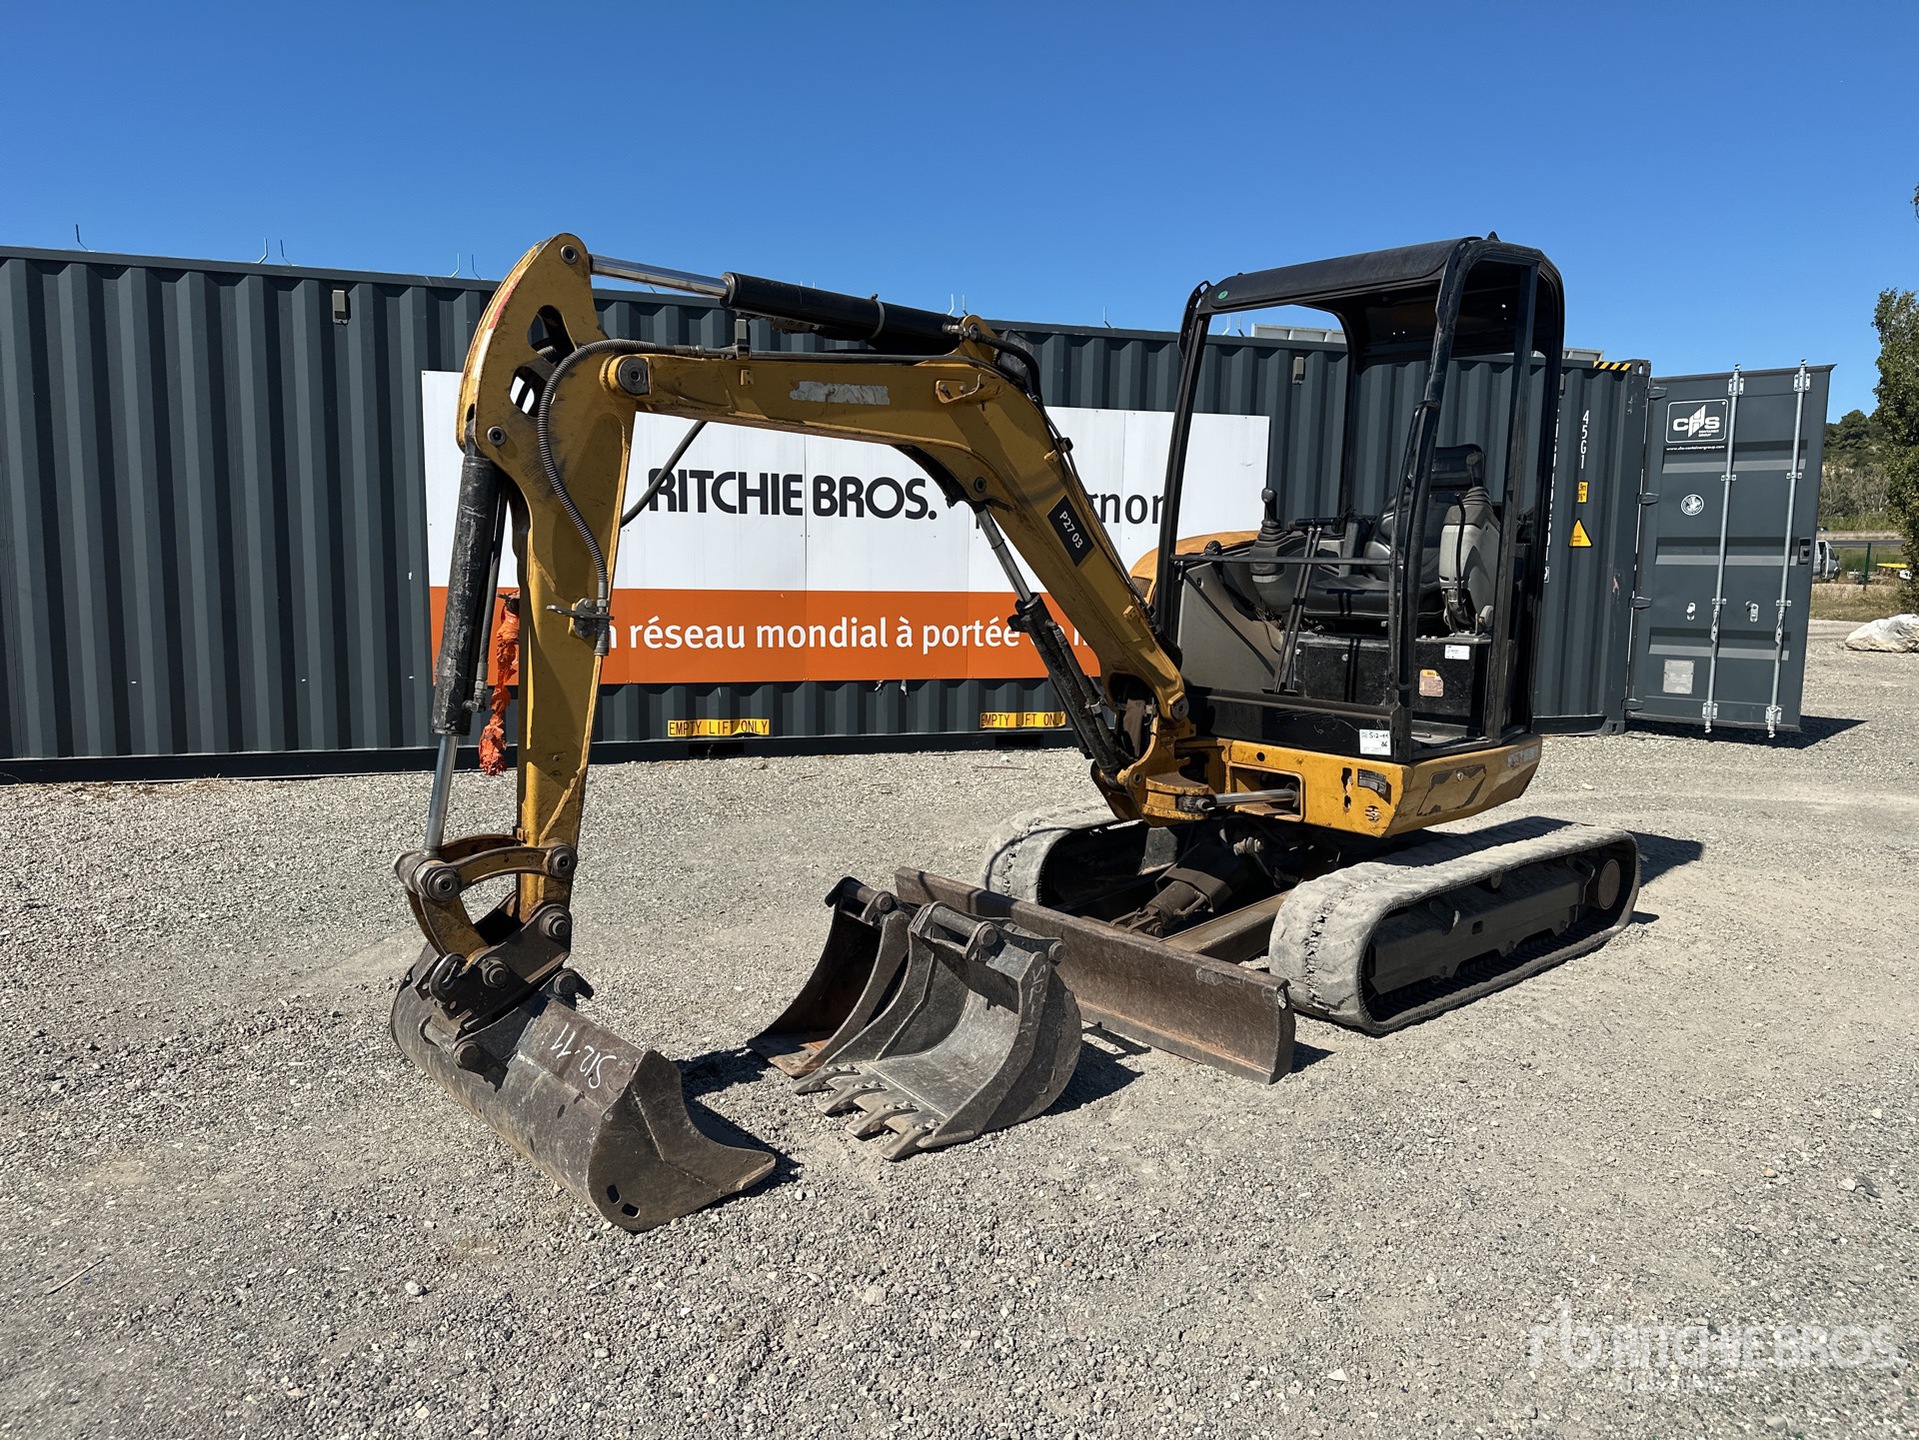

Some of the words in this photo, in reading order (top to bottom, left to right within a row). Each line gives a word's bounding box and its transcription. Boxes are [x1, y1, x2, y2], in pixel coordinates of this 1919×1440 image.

[1580, 409, 1590, 470] 45G1
[648, 468, 803, 516] RITCHIE
[813, 475, 937, 520] BROS.
[629, 615, 746, 649] réseau
[756, 616, 888, 648] mondial
[895, 616, 914, 648] à
[922, 616, 1020, 656] portée
[669, 720, 702, 736] EMPTY
[708, 720, 735, 735] LIFT
[740, 719, 768, 733] ONLY
[980, 713, 1010, 727] EMPTY
[1016, 712, 1037, 727] LIFT
[1043, 712, 1065, 727] ONLY
